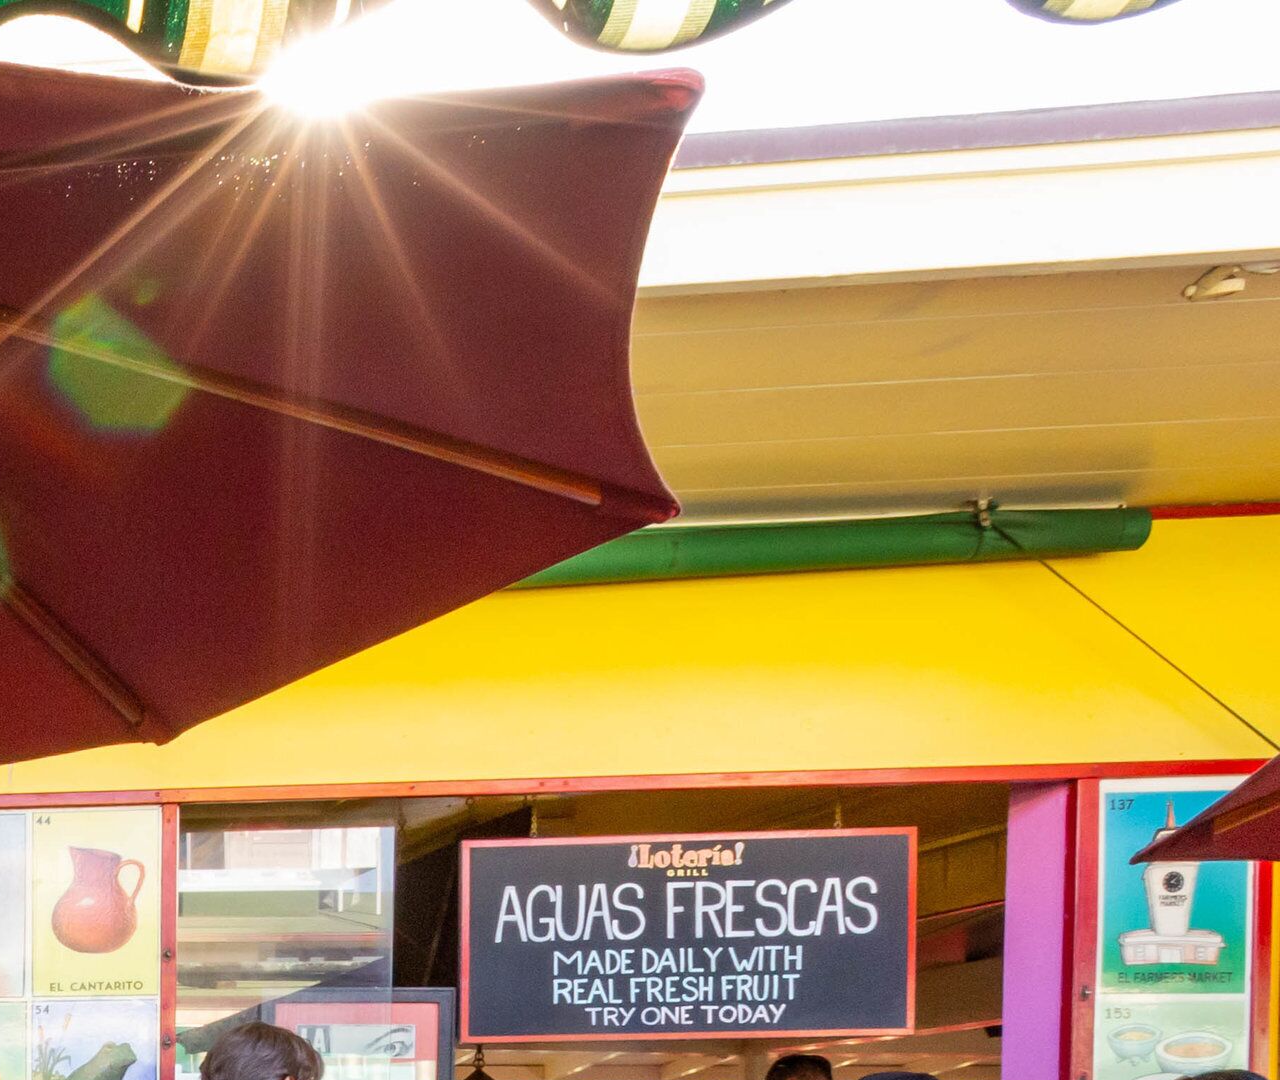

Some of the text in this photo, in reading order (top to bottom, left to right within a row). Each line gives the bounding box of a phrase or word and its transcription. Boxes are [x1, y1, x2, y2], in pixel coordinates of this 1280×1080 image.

[1110, 799, 1134, 811] 137
[37, 816, 51, 826] 44
[667, 869, 709, 877] GRILL
[495, 876, 878, 944] AGUAS FRESCAS
[553, 945, 803, 976] MADE DAILY WITH
[1118, 972, 1233, 983] EL FARMERS MARKET
[49, 980, 144, 992] EL CANTARITO
[553, 974, 801, 1005] REAL FRESH FRUIT
[35, 1005, 50, 1015] 54
[585, 1003, 787, 1027] TRY ONE TODAY
[1105, 1008, 1132, 1019] 153
